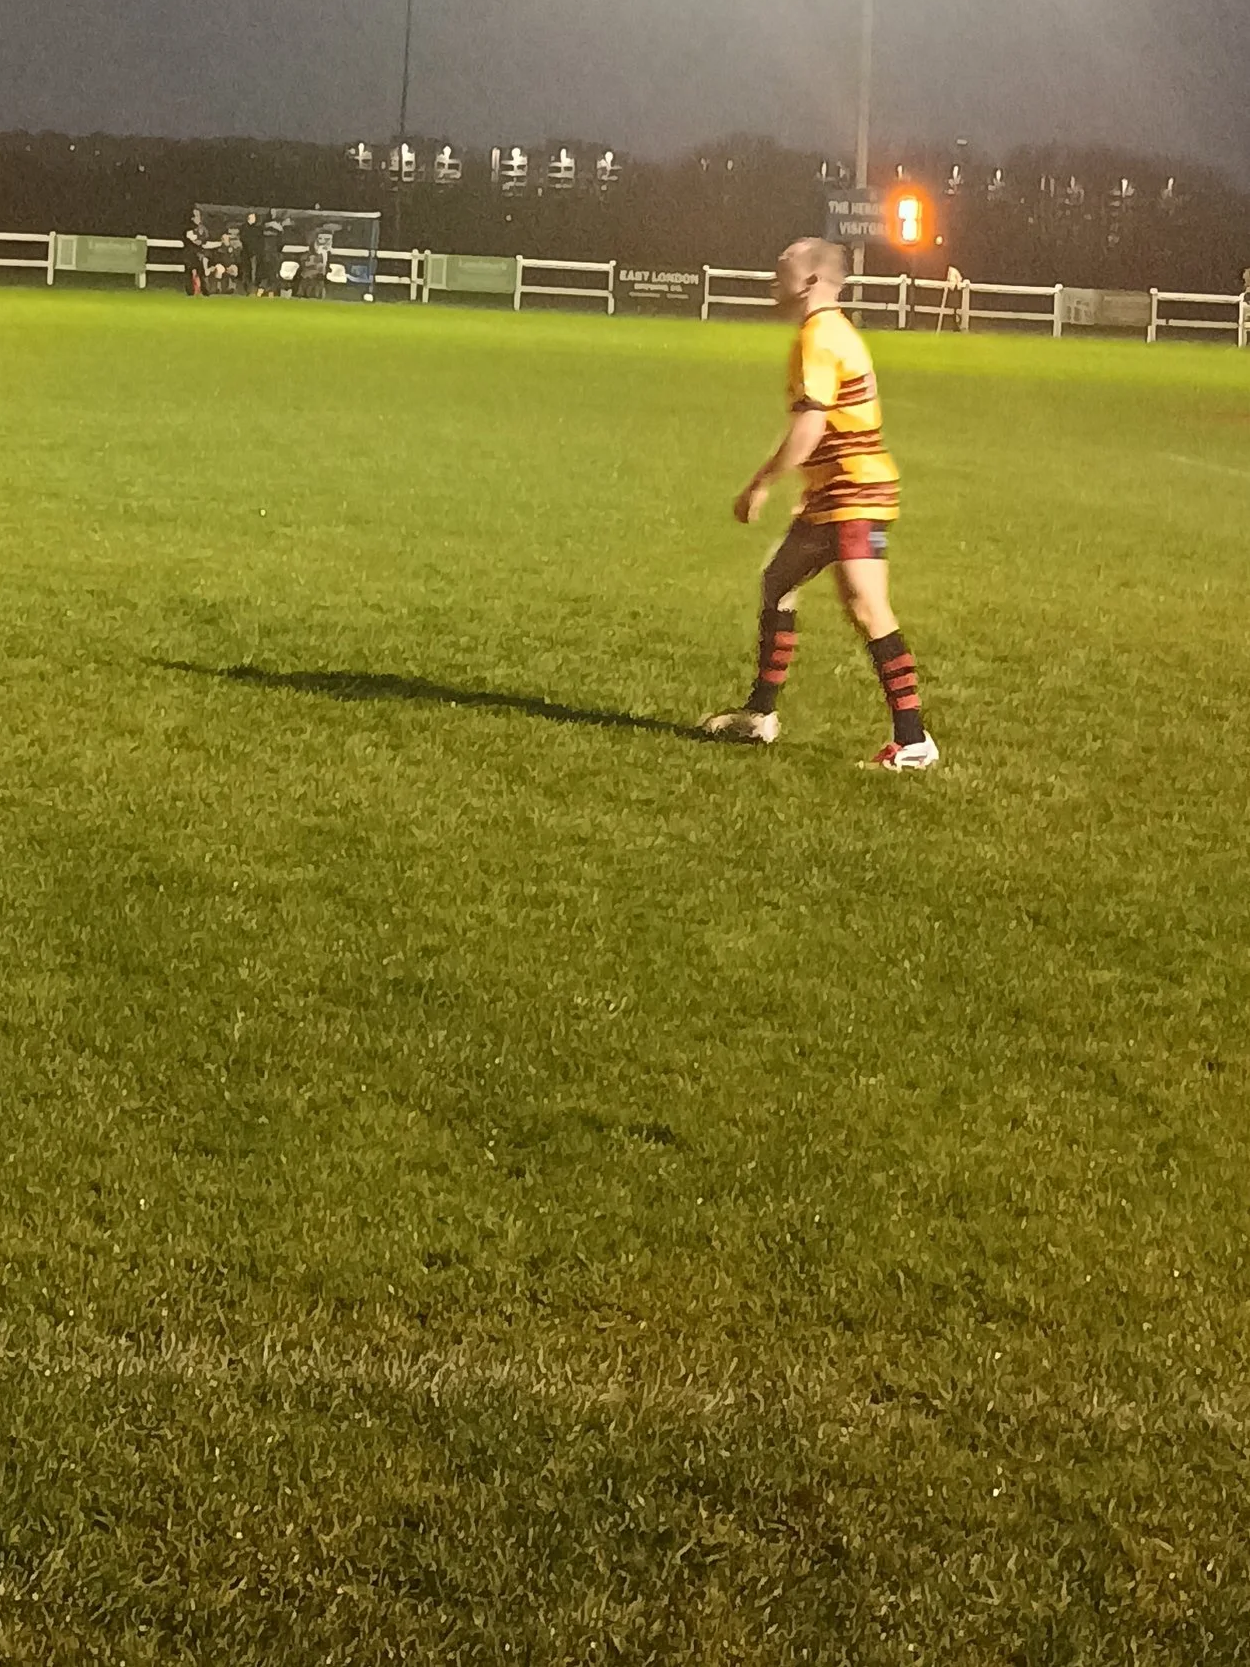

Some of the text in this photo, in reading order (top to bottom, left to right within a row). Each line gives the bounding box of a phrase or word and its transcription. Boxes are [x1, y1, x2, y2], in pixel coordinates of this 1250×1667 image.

[828, 200, 850, 215] THE
[619, 269, 699, 285] EAST LONDON
